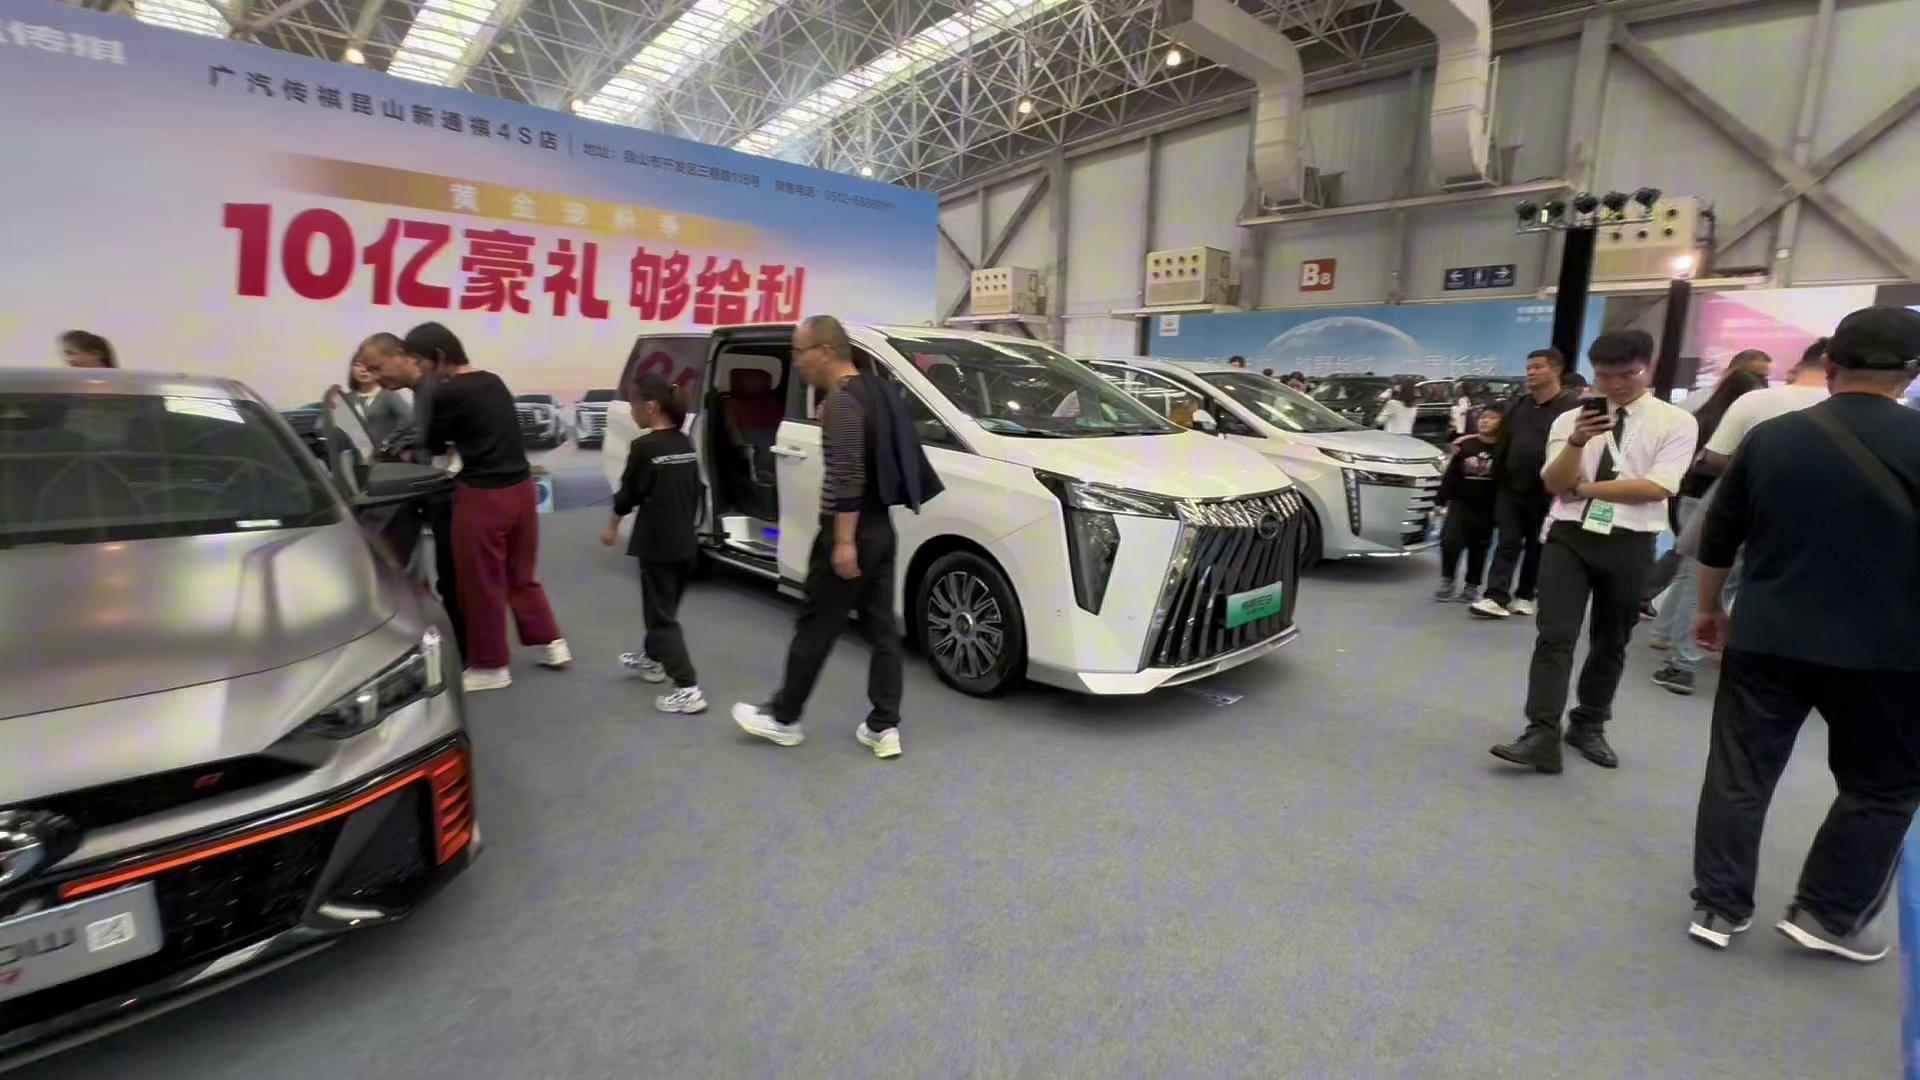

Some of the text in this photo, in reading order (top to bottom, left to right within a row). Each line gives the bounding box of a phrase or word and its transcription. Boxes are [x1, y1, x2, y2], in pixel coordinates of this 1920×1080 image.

[0, 19, 127, 66] 传祺
[222, 202, 806, 326] 10亿豪礼 够给利
[1301, 262, 1332, 287] B8
